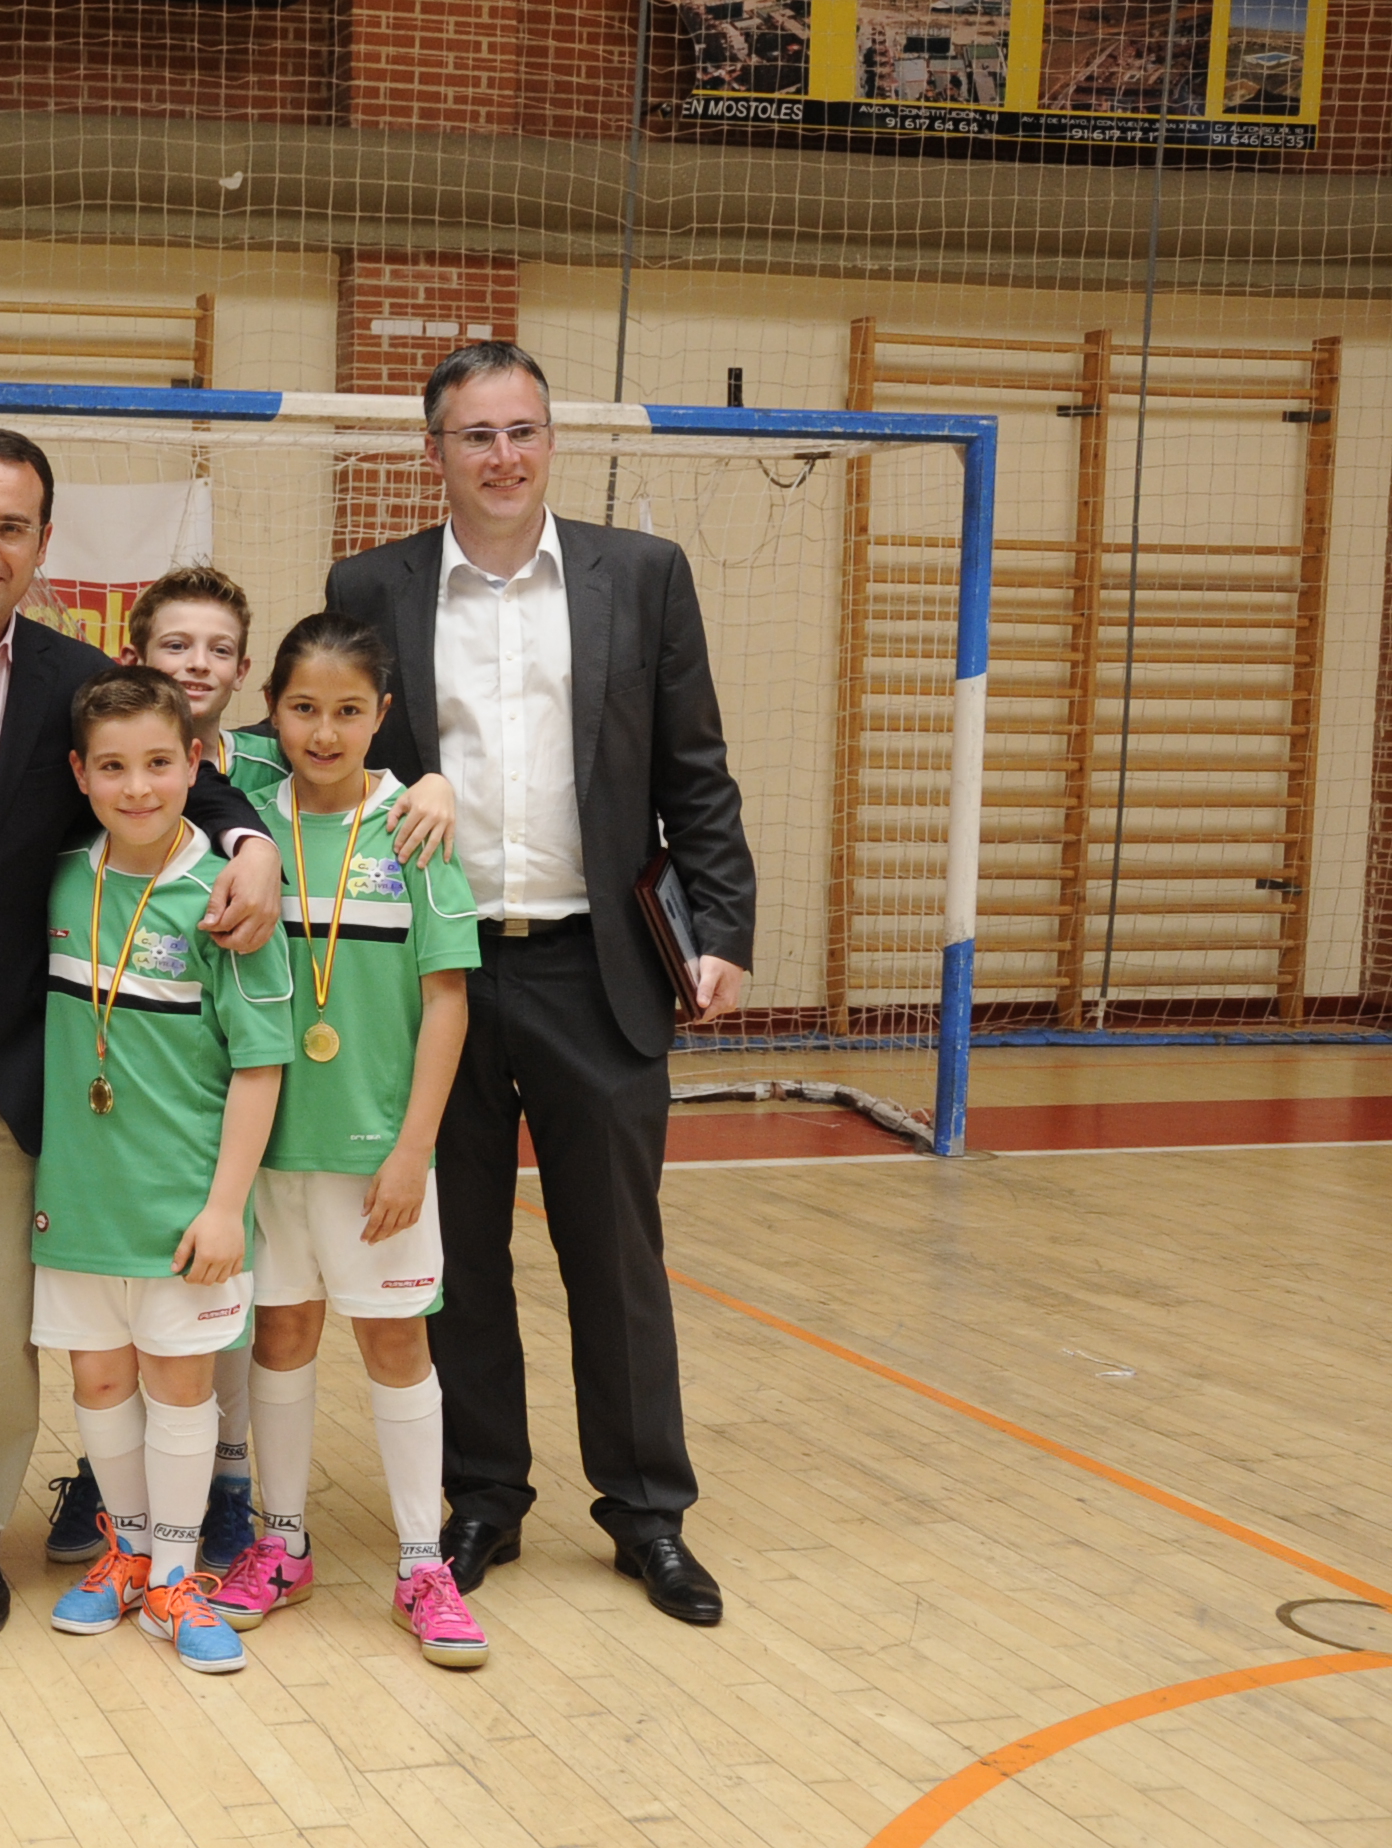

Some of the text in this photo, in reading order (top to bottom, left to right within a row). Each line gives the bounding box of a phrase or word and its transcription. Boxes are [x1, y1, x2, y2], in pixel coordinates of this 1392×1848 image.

[708, 100, 803, 120] MOSTOLES
[885, 117, 979, 132] 91 617 64 64
[1072, 128, 1088, 139] 91
[1092, 129, 1120, 140] 617
[1127, 130, 1143, 142] 17
[1212, 133, 1305, 148] 91 646 35 35
